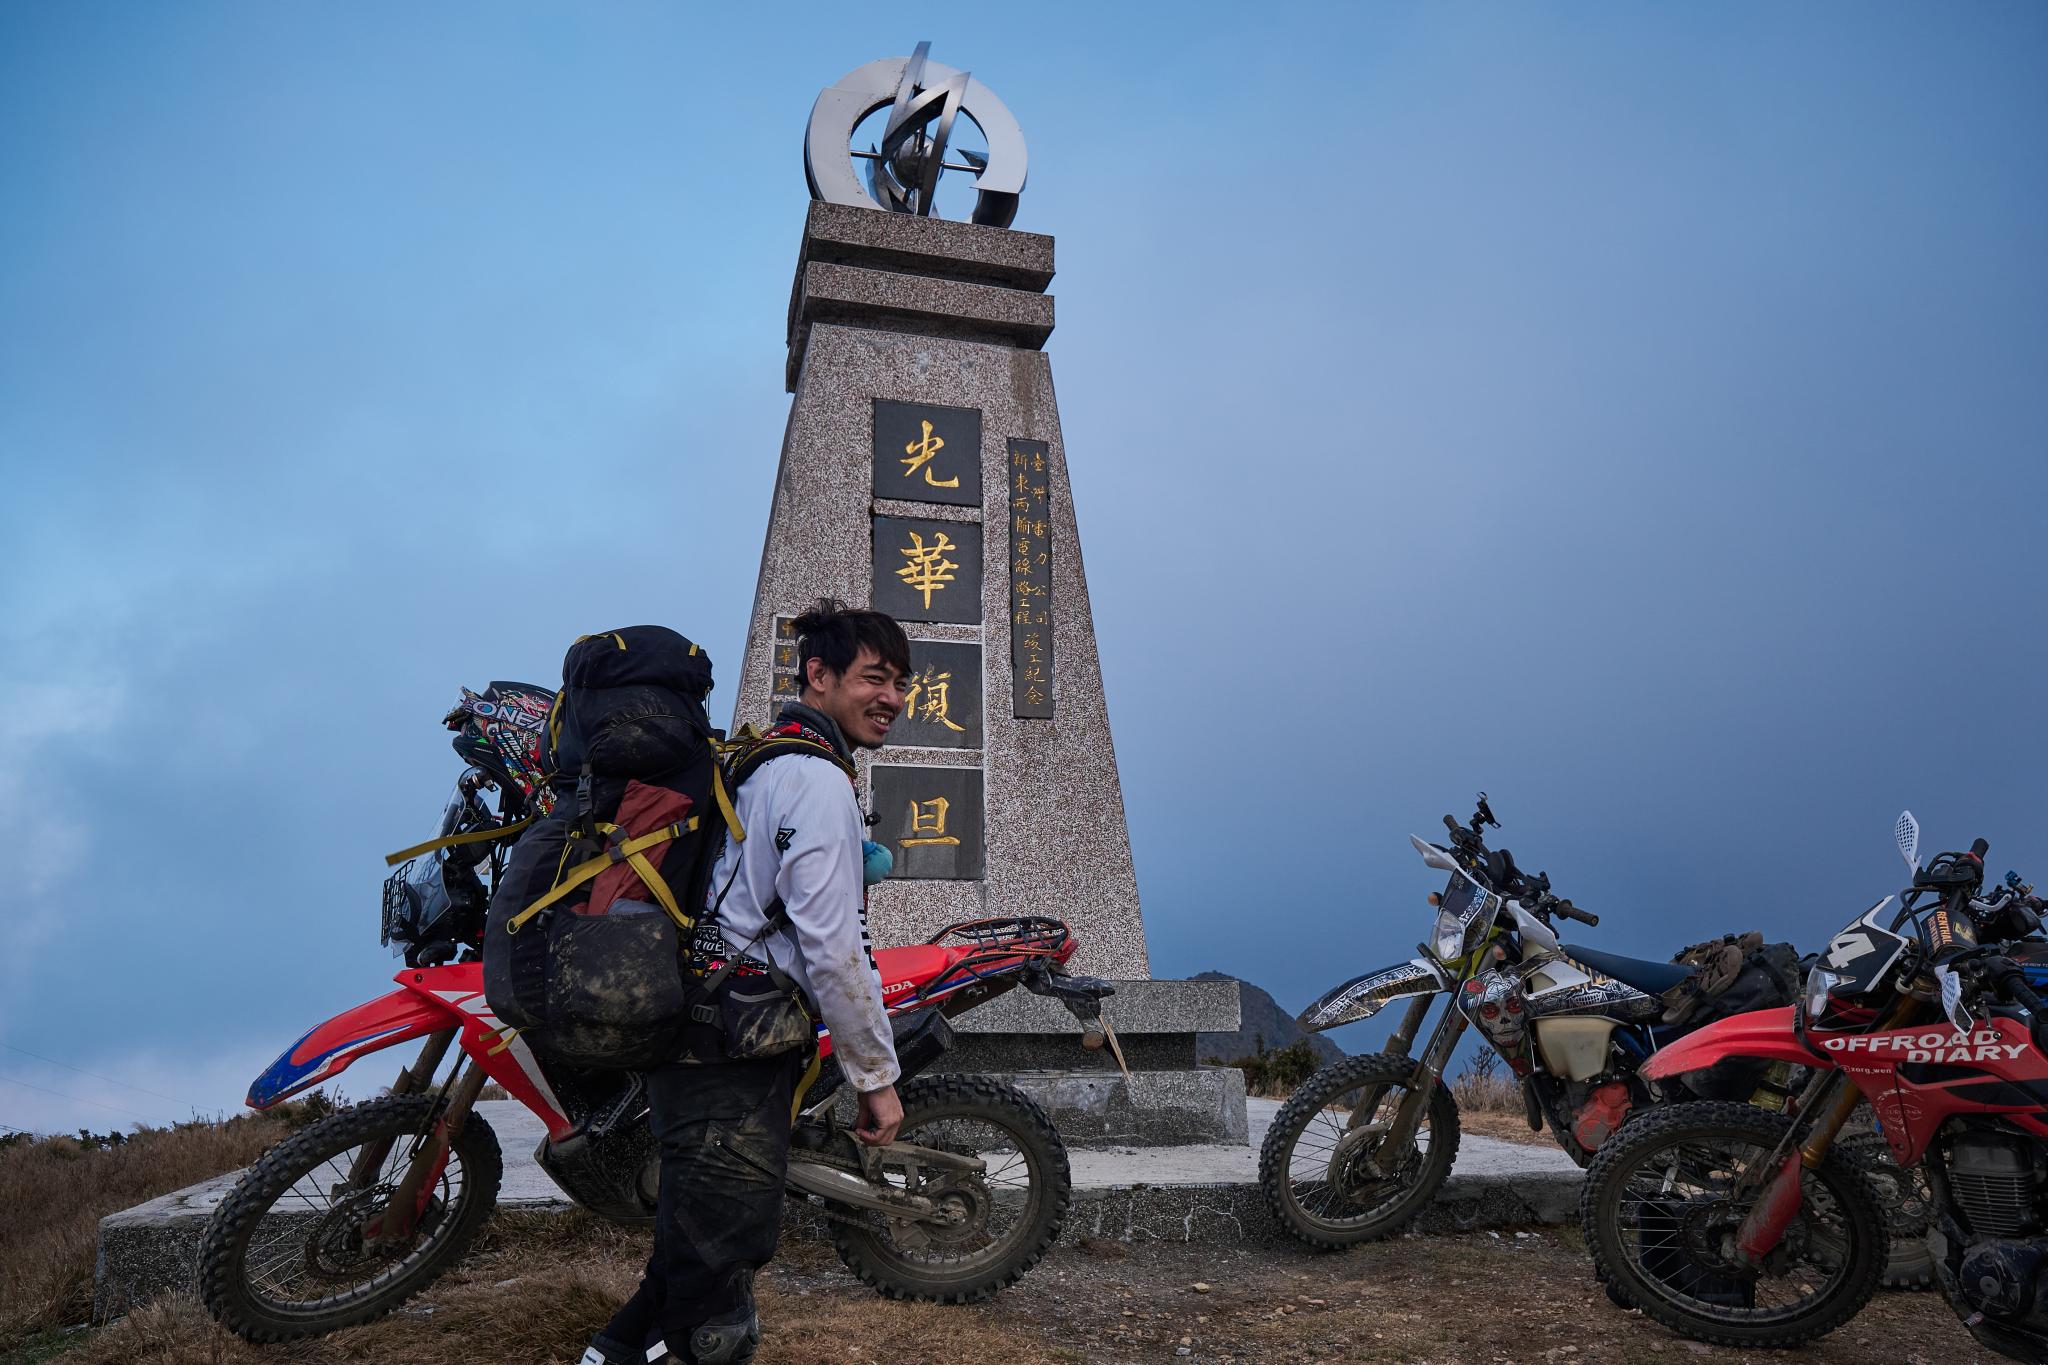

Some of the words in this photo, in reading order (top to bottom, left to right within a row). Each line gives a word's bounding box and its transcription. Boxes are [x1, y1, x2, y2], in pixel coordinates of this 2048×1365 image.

[881, 980, 915, 996] NDA
[1824, 1030, 2000, 1052] OFFROAD
[1906, 1043, 2029, 1064] DIARY
